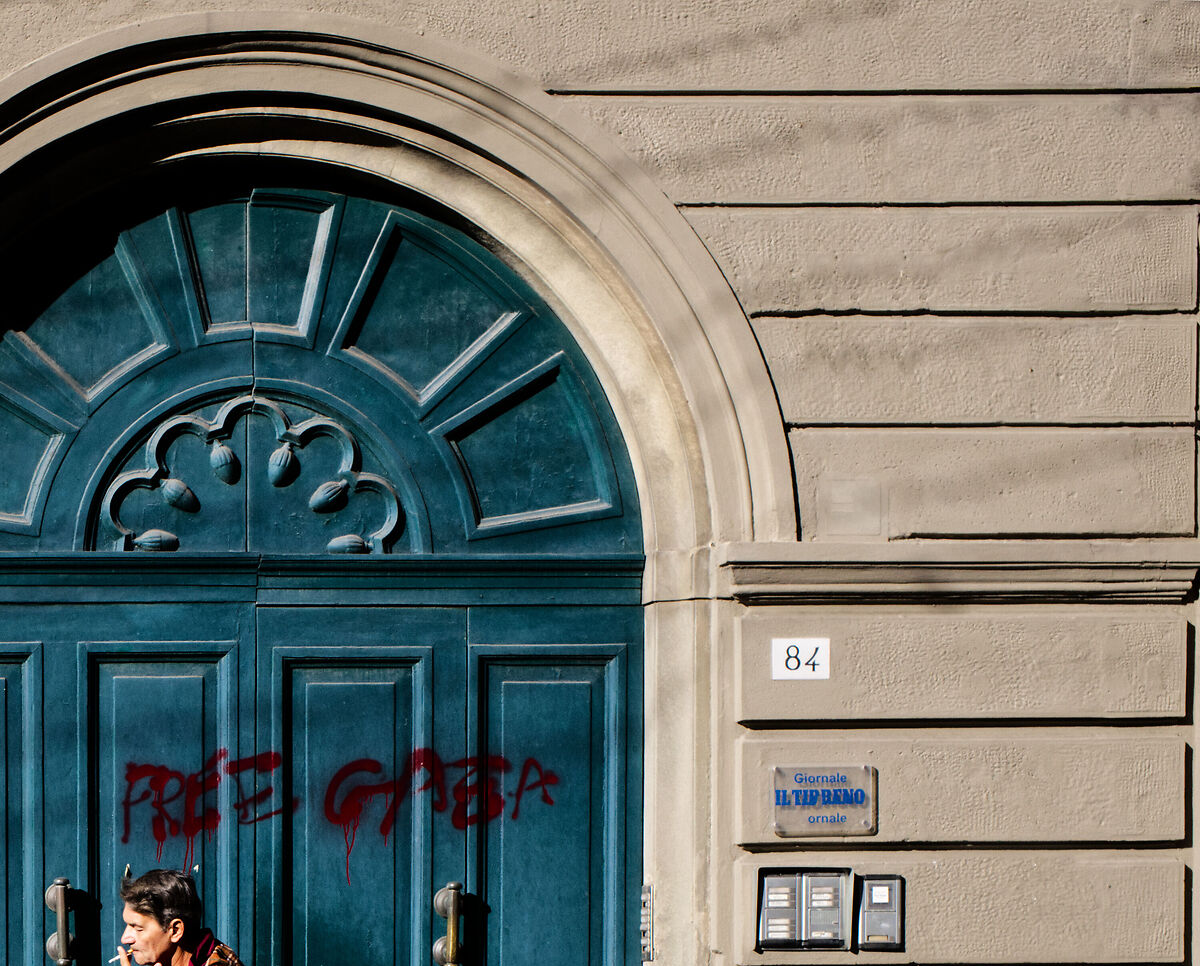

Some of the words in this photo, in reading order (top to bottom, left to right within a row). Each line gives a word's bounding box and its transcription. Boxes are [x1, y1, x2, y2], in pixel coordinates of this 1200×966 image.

[785, 644, 820, 672] 84
[794, 772, 847, 784] Giornale
[775, 789, 791, 806] IL
